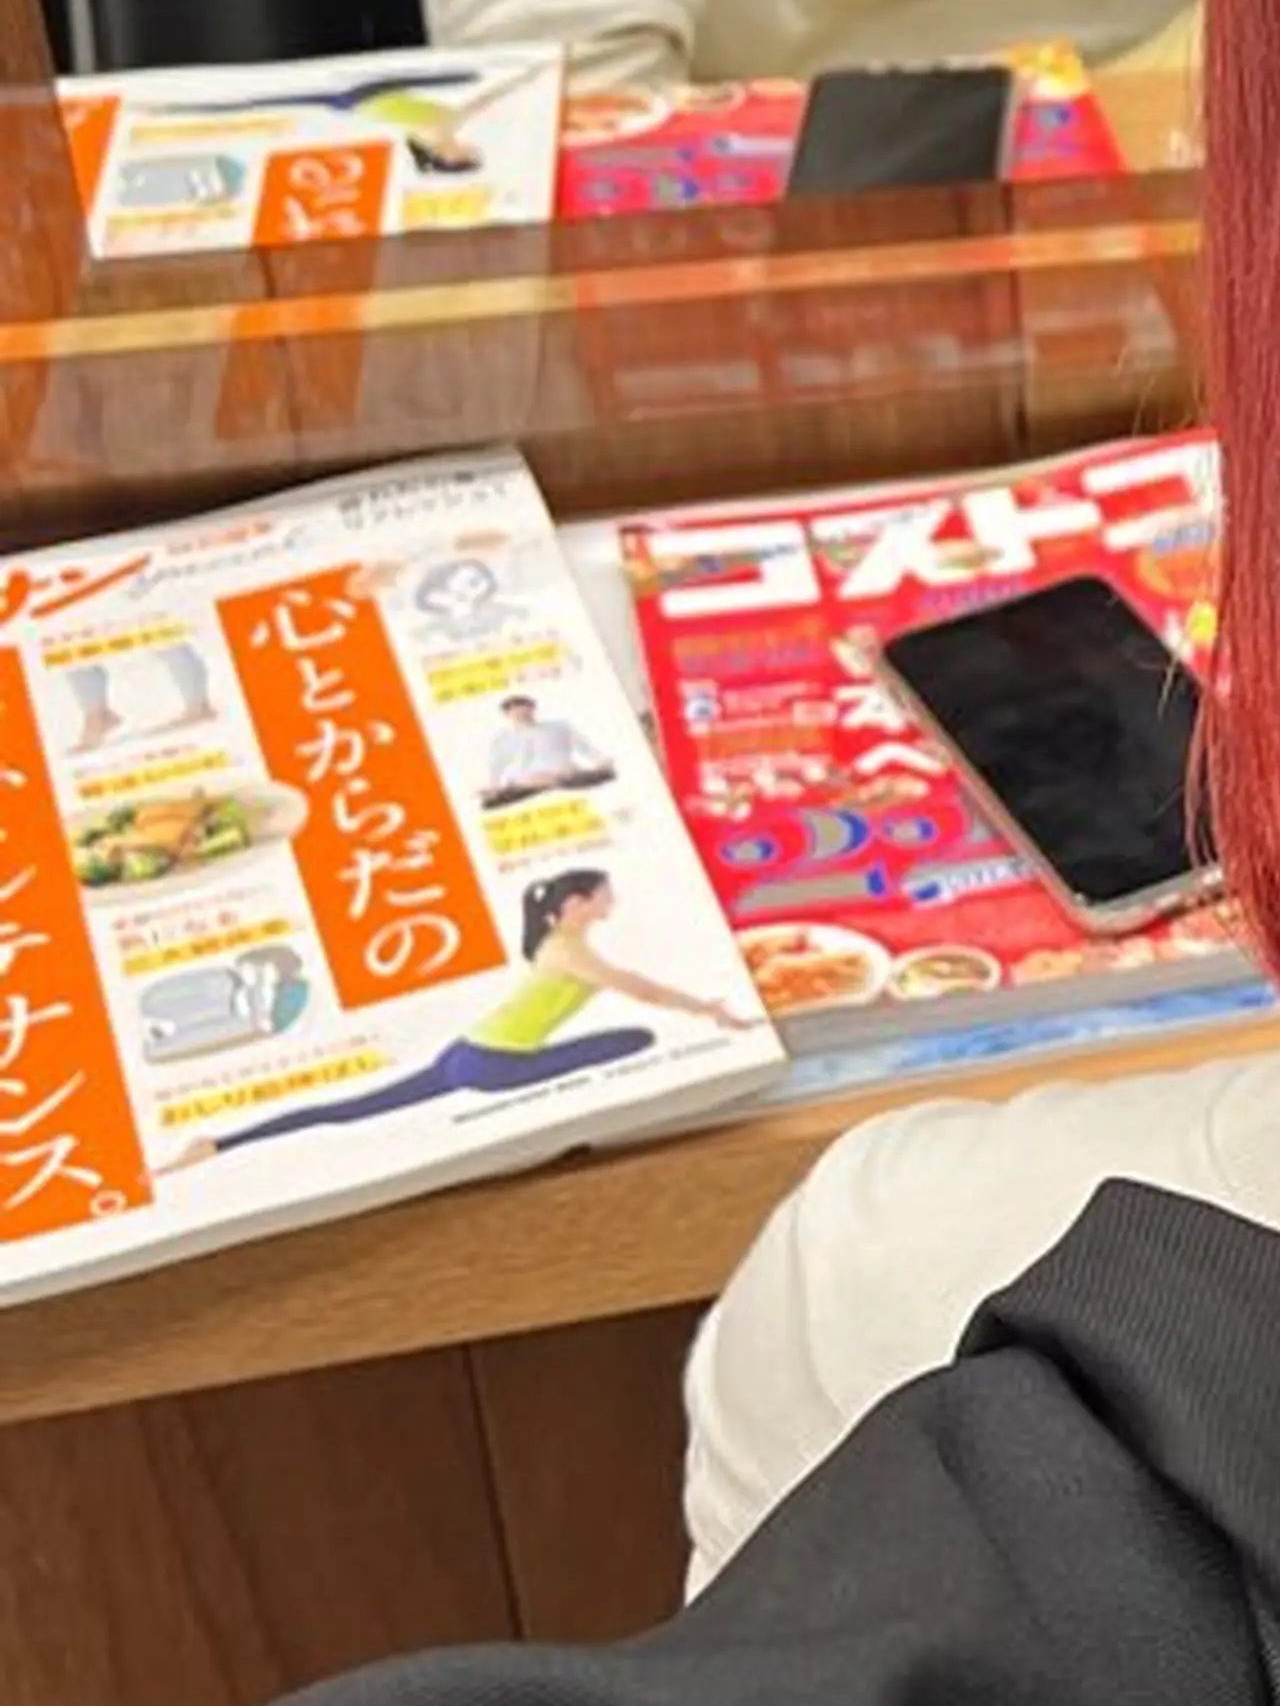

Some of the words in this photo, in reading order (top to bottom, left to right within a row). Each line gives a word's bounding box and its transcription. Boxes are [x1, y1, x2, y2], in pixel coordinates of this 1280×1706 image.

[250, 586, 462, 981] 心とからだの
